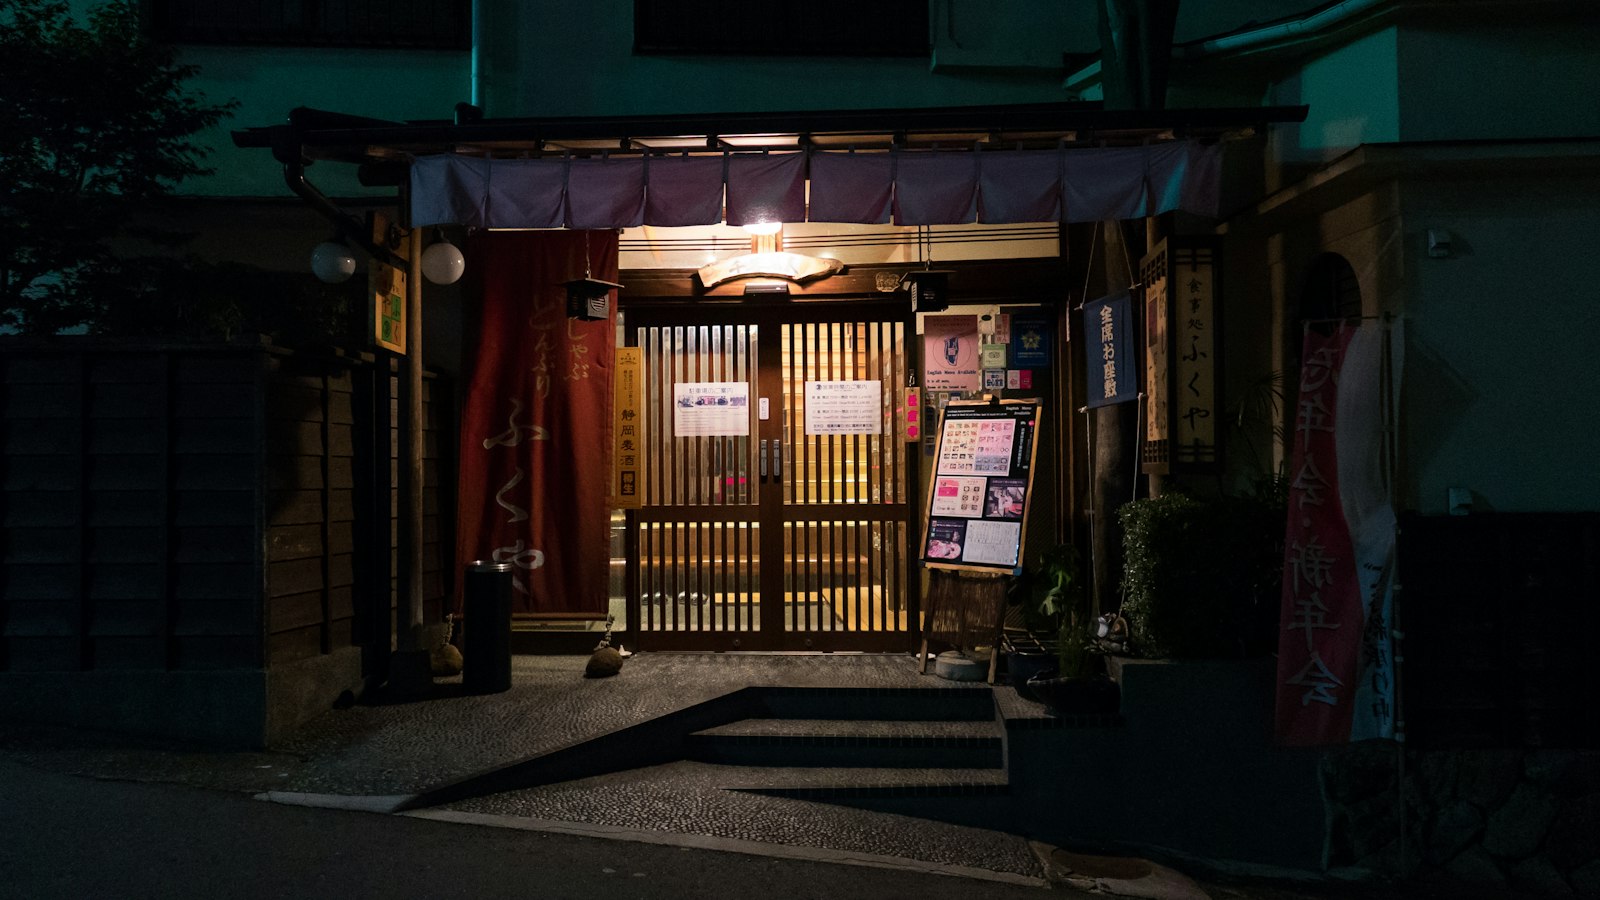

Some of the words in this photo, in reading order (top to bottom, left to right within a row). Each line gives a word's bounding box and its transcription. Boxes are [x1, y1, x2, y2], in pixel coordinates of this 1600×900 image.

[1100, 304, 1118, 399] 全席お座敷
[620, 409, 636, 466] 静岡麦酒
